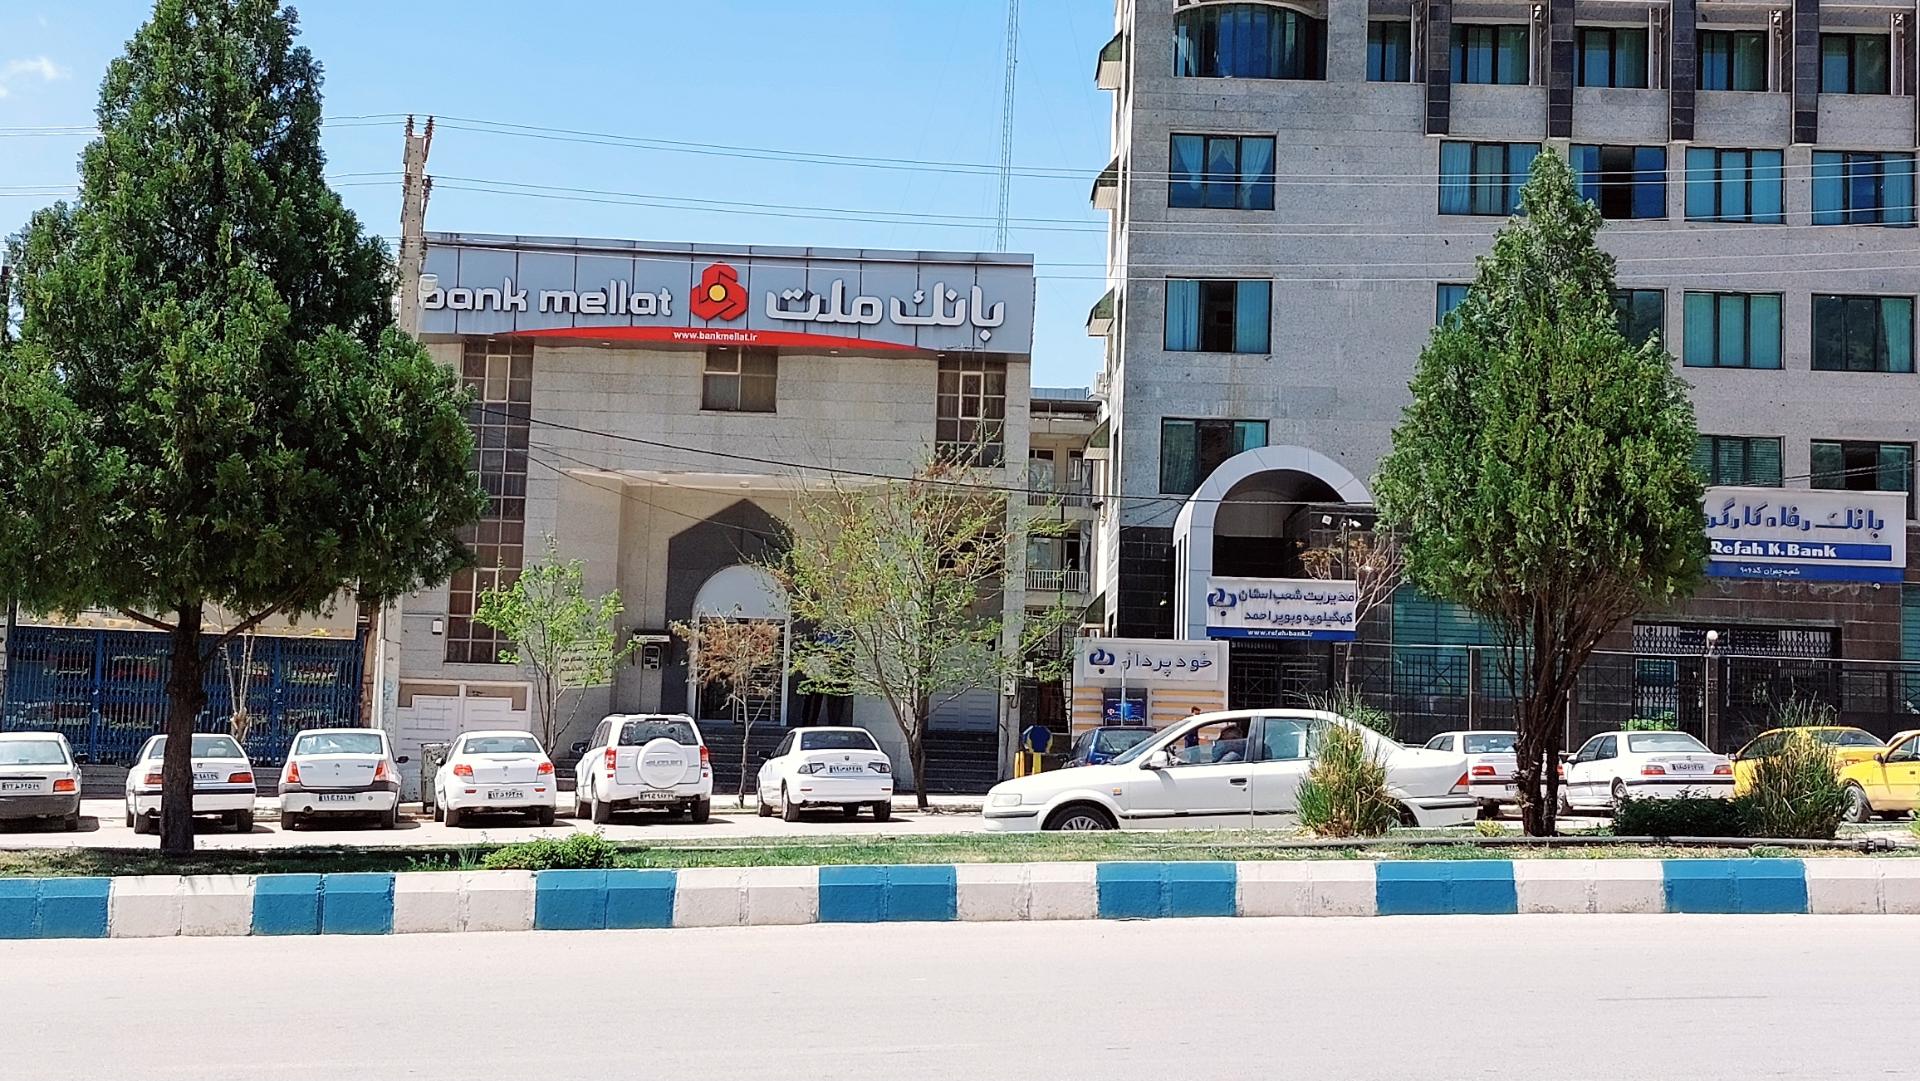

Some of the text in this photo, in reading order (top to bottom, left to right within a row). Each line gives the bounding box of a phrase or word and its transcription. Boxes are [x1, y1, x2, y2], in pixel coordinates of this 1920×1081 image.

[539, 279, 671, 315] mellat
[766, 279, 883, 324] ملت
[673, 331, 758, 341] www.bankmellat.ir
[1766, 506, 1811, 531] رفاه
[1711, 541, 1764, 556] Refah
[1304, 591, 1355, 605] مدیریت
